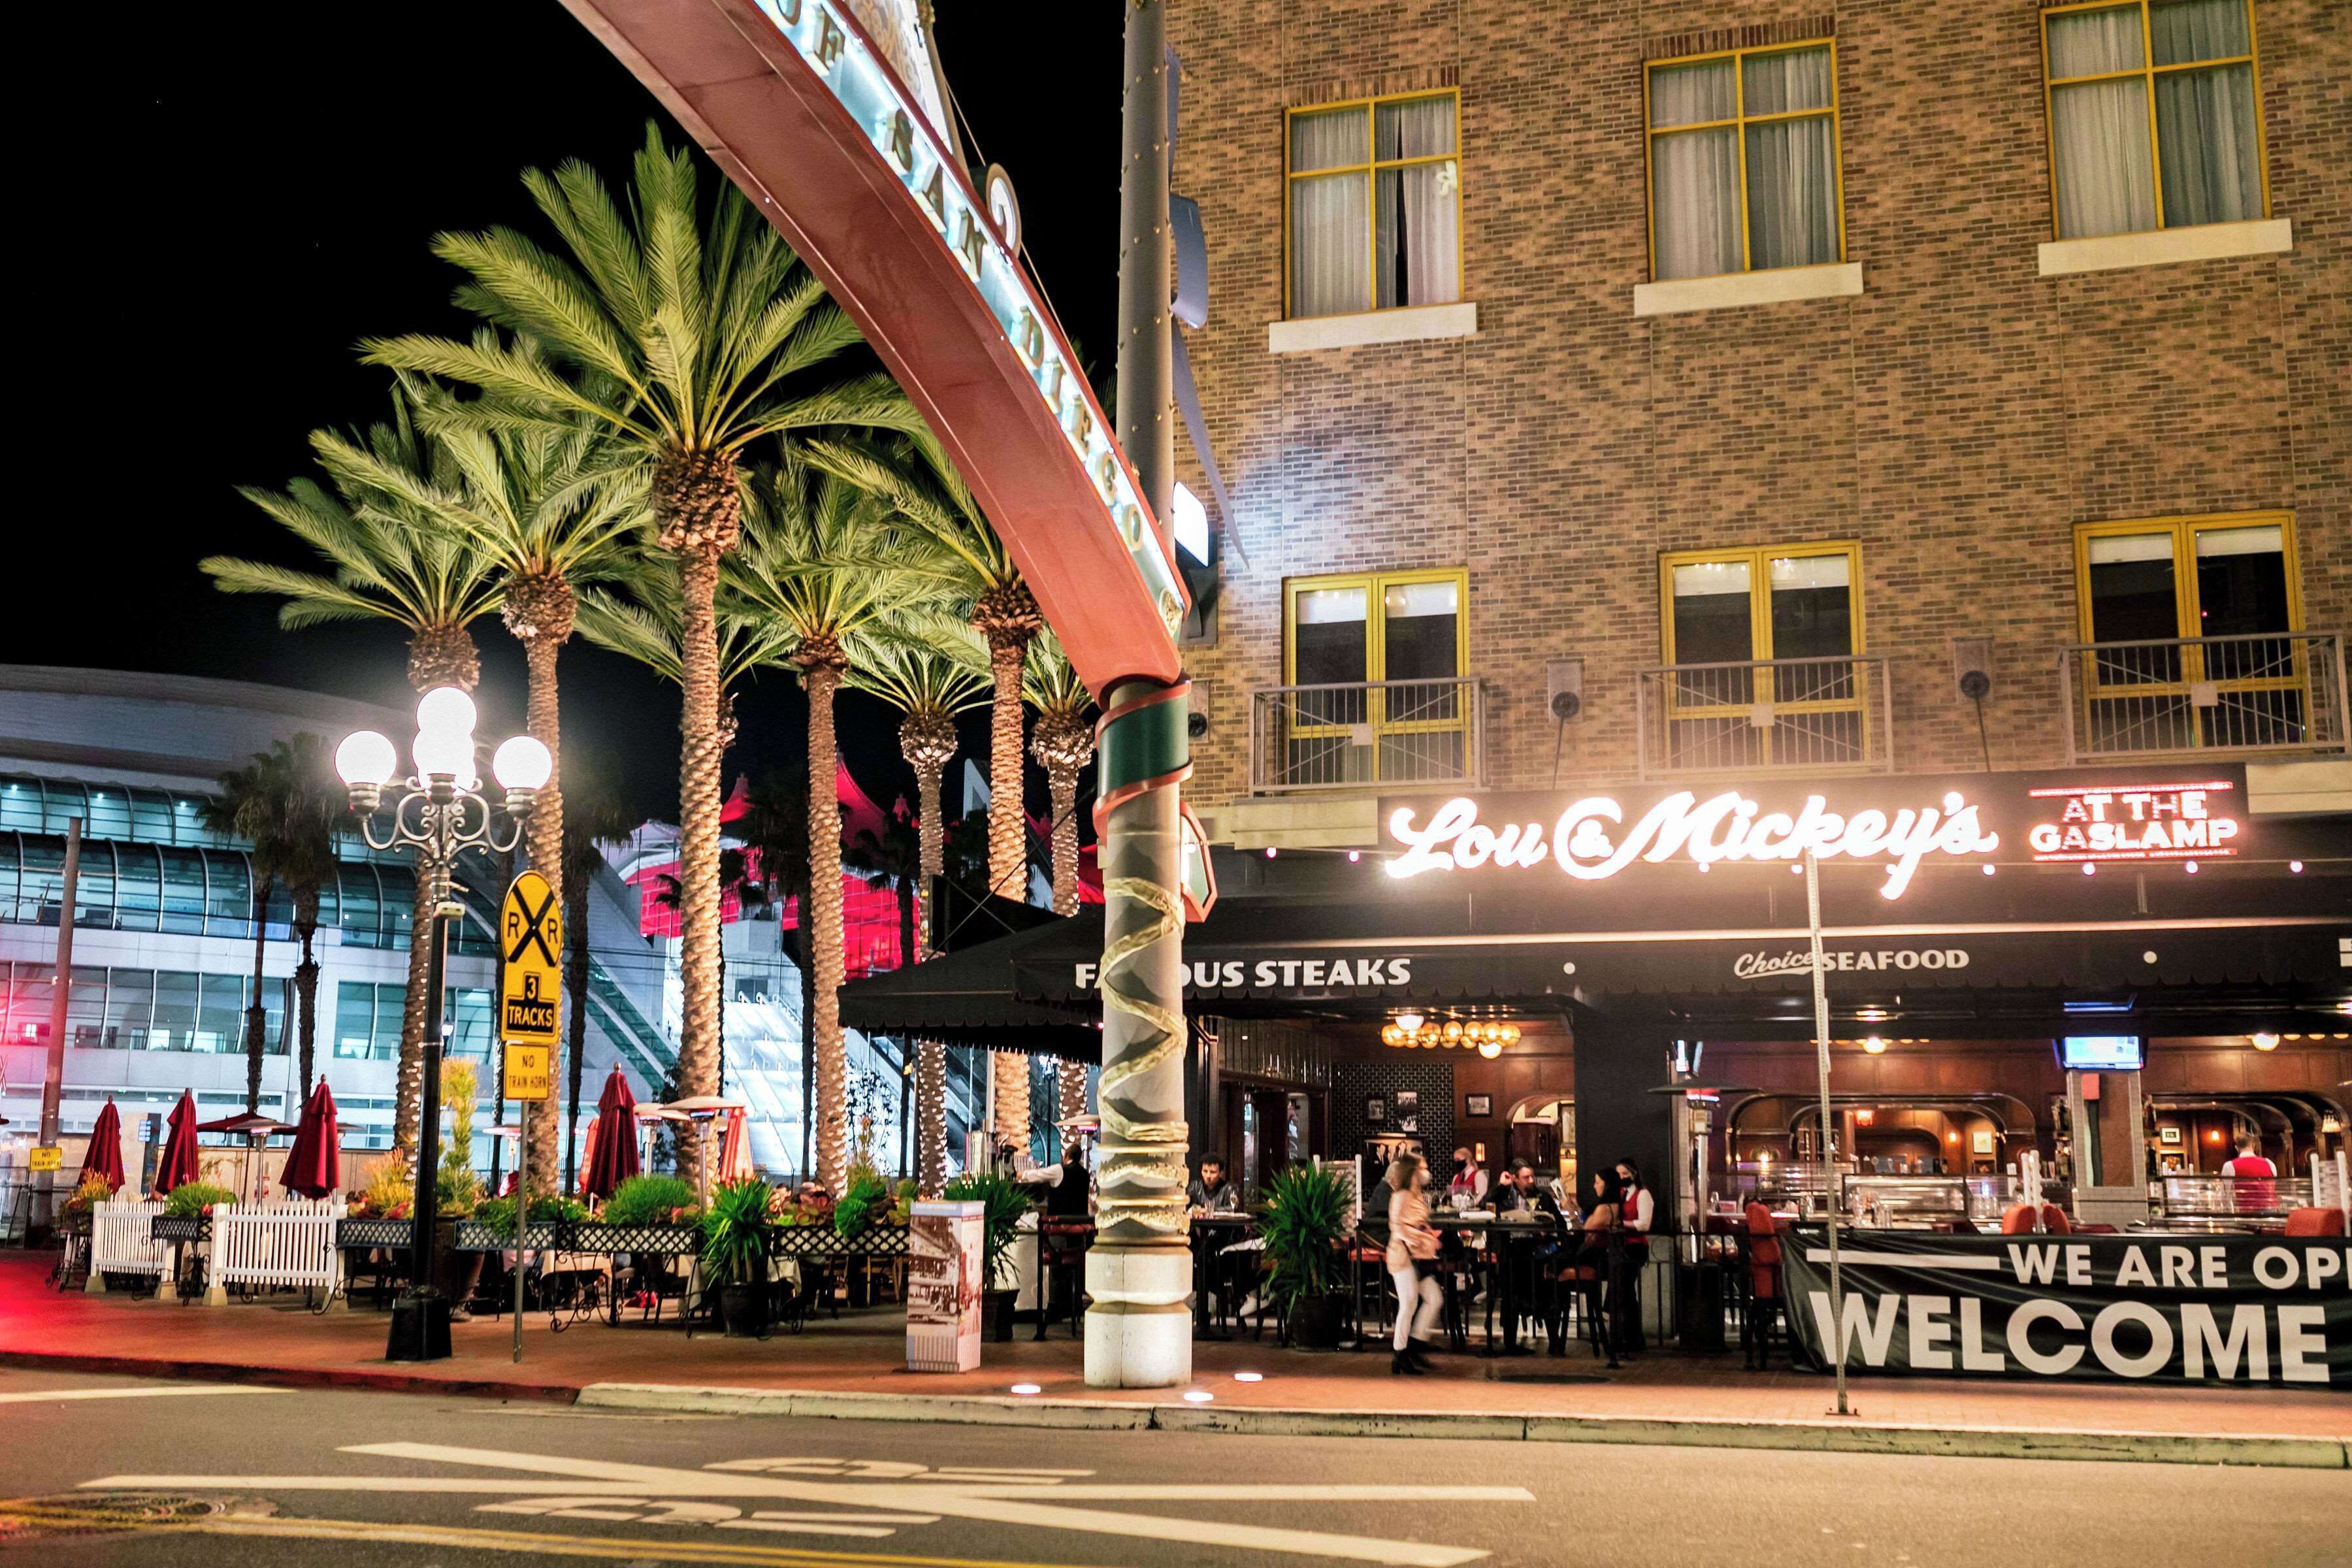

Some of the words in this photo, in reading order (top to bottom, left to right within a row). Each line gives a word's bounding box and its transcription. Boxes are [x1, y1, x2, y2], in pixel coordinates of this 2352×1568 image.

[883, 108, 985, 282] SAN
[1015, 305, 1142, 551] DIEGO
[2061, 793, 2112, 823] AT
[2123, 791, 2208, 821] THE
[1385, 797, 1547, 879] Lou
[1641, 791, 1999, 900] Mickey's
[2030, 819, 2239, 852] GASLAMP
[508, 911, 520, 939] R
[547, 917, 558, 943] R
[1075, 960, 1244, 988] FUS
[1255, 958, 1411, 986] STEAKS
[1734, 951, 1814, 977] Choice
[1821, 949, 1970, 972] SEAFOOD
[526, 977, 536, 999] 3
[508, 1005, 553, 1028] TRACKS
[522, 1055, 534, 1068] NO
[509, 1075, 527, 1089] TRAIN
[530, 1076, 547, 1089] HORN
[2007, 1243, 2093, 1286] WE
[2115, 1245, 2229, 1290] ARE
[2253, 1246, 2352, 1290] OP
[1808, 1291, 2330, 1382] WELCOME
